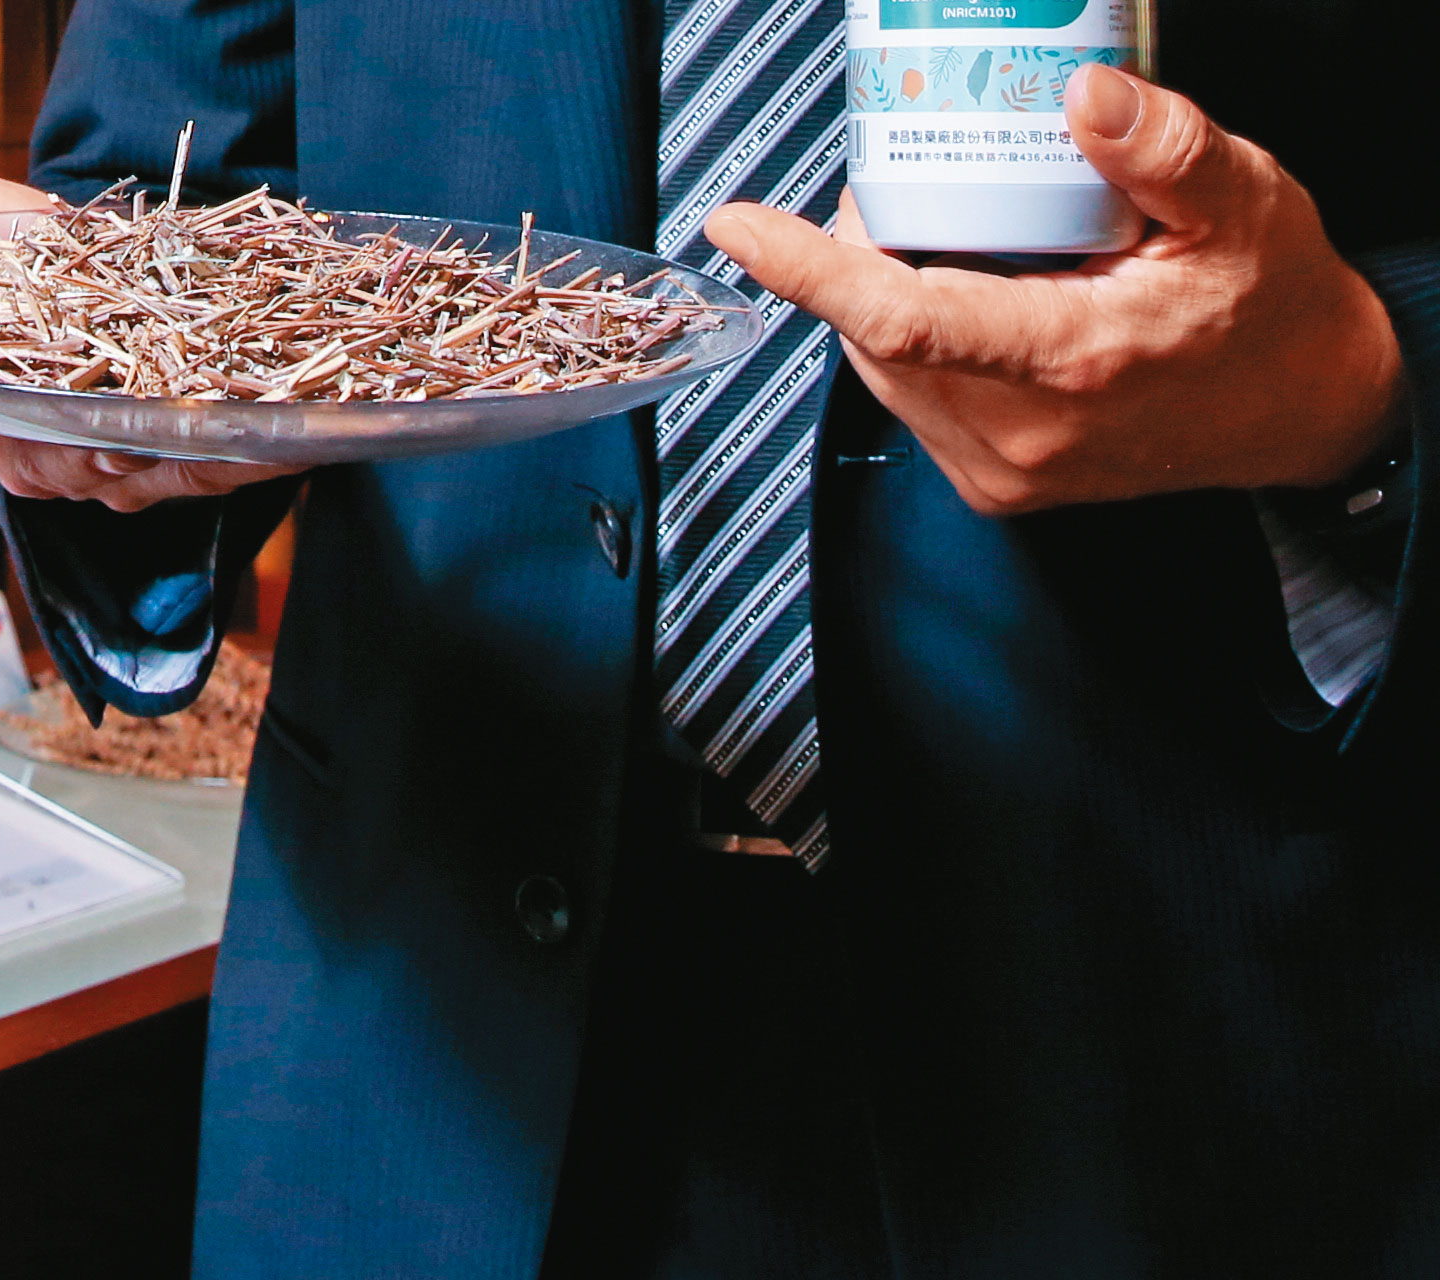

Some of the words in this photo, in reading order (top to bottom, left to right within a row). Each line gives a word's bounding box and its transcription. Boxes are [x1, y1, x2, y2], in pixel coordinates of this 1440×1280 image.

[942, 6, 1016, 19] (NRICM101)
[888, 130, 1074, 145] 勝昌製藥廠股份有限公司中壢
